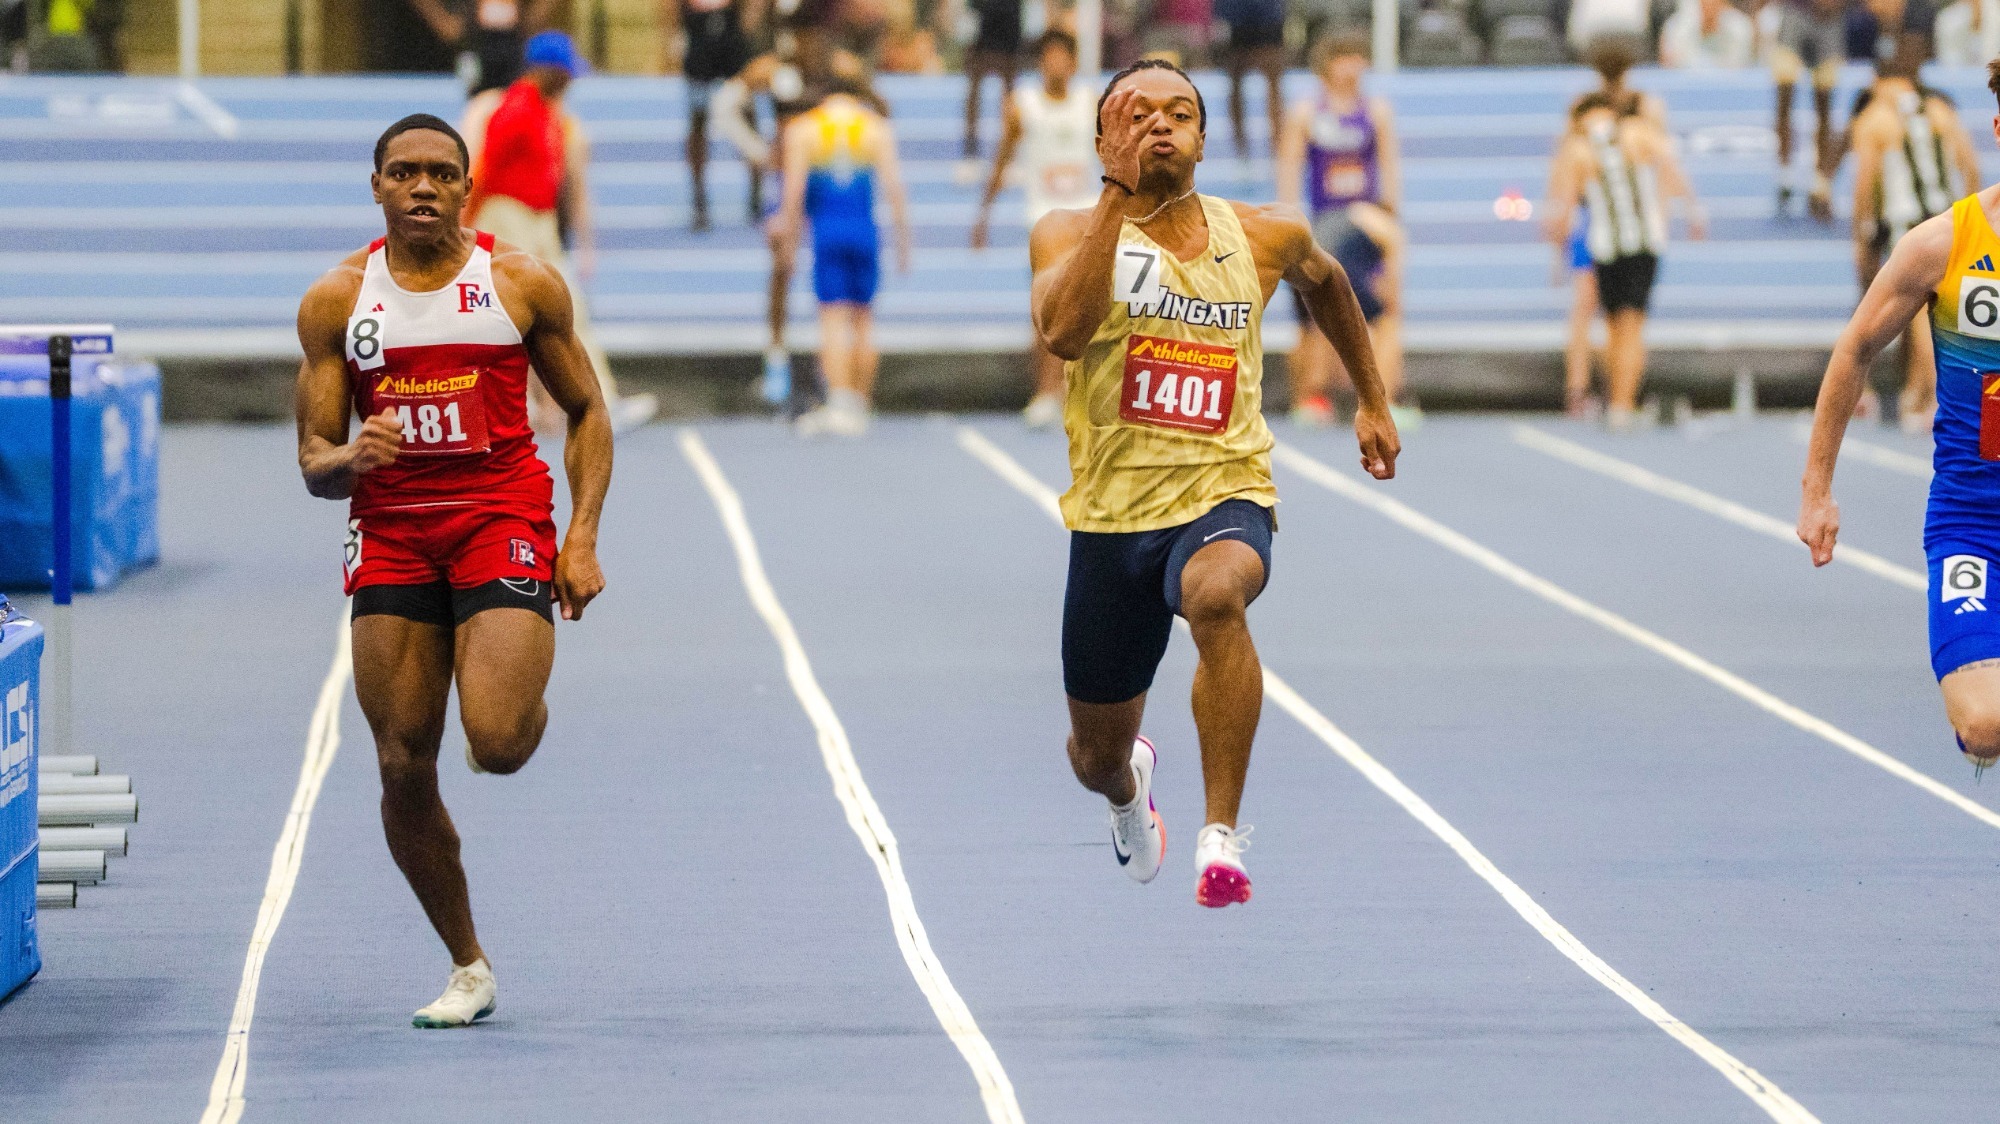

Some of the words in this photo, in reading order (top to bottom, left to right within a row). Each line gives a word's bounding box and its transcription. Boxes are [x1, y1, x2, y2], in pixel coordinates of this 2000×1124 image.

[1123, 251, 1156, 294] 7
[1964, 285, 2000, 328] 6
[352, 318, 380, 360] 8
[1132, 369, 1223, 420] 1401
[1949, 560, 1982, 590] 6
